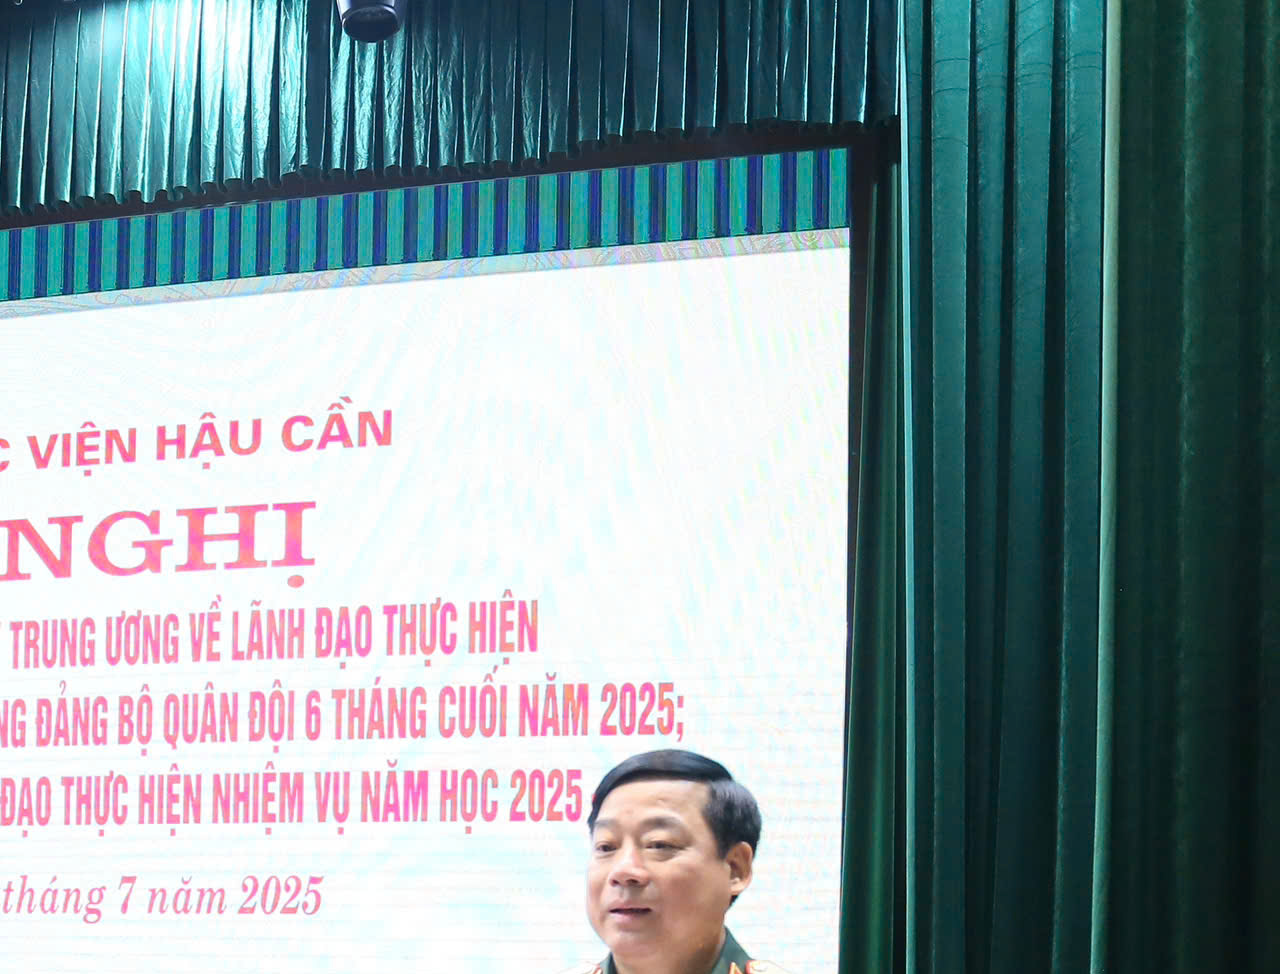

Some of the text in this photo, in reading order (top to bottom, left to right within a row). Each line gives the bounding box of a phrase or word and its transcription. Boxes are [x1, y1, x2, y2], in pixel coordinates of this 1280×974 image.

[27, 421, 136, 477] VIỆN
[156, 412, 262, 470] HẬU
[282, 397, 392, 452] CẦN
[10, 617, 96, 669] TRUNG
[105, 611, 179, 666] ƯƠNG
[190, 595, 222, 662] VỀ
[232, 601, 305, 661] LÃNH
[315, 605, 372, 670] ĐẠO
[383, 597, 458, 667] THỰC
[469, 590, 538, 664] HIỆN
[35, 683, 108, 747] ĐẢNG
[118, 684, 153, 757] BỘ
[163, 682, 238, 750] QUÂN
[248, 680, 295, 754] ĐỘI
[305, 690, 321, 741] 6
[332, 676, 427, 740] THÁNG
[440, 665, 508, 739] CUỐI
[520, 672, 589, 736] NĂM
[600, 682, 684, 742] 2025;
[0, 777, 52, 838] ĐẠO
[61, 770, 128, 837] THỰC
[139, 764, 202, 836] HIỆN
[212, 763, 304, 835] NHIỆM
[315, 771, 350, 835] VỤ
[361, 759, 429, 823] NĂM
[440, 769, 498, 834] HỌC
[509, 769, 582, 823] 2025
[3, 875, 107, 924] tháng
[118, 876, 136, 914] 7
[148, 875, 225, 915] năm
[238, 875, 323, 915] 2025
